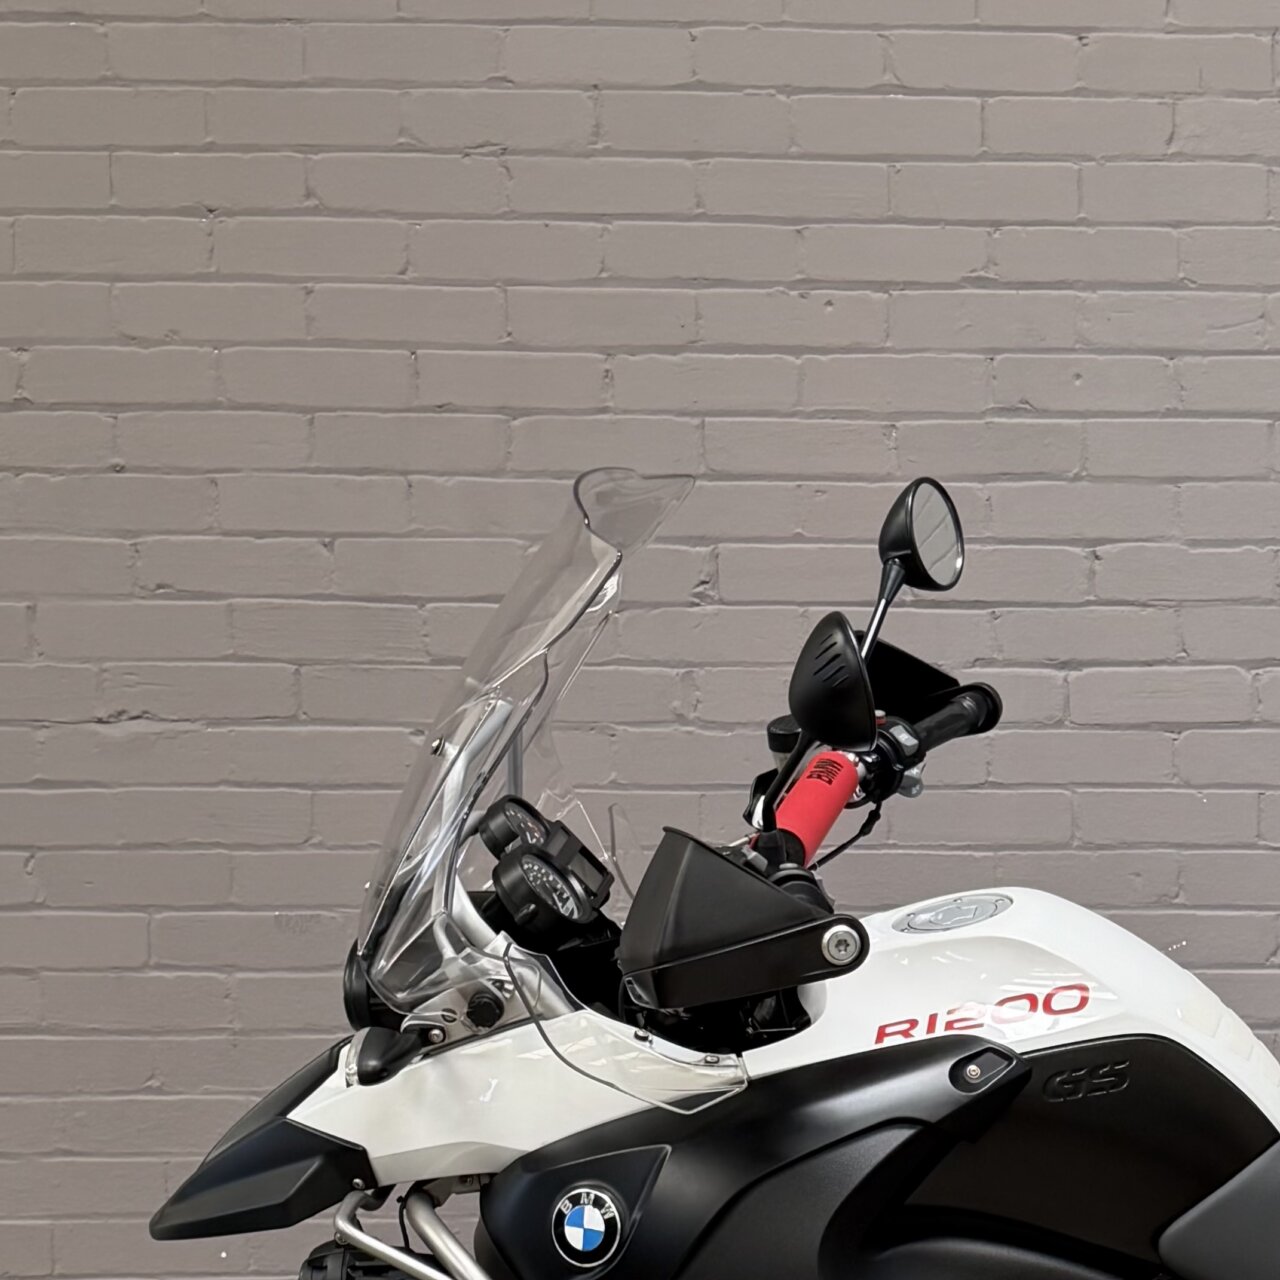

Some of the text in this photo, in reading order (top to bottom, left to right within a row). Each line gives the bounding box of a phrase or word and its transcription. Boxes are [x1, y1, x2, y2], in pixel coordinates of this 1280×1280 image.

[806, 758, 844, 786] BMW
[1043, 1060, 1130, 1102] GS
[560, 1191, 615, 1219] BMW
